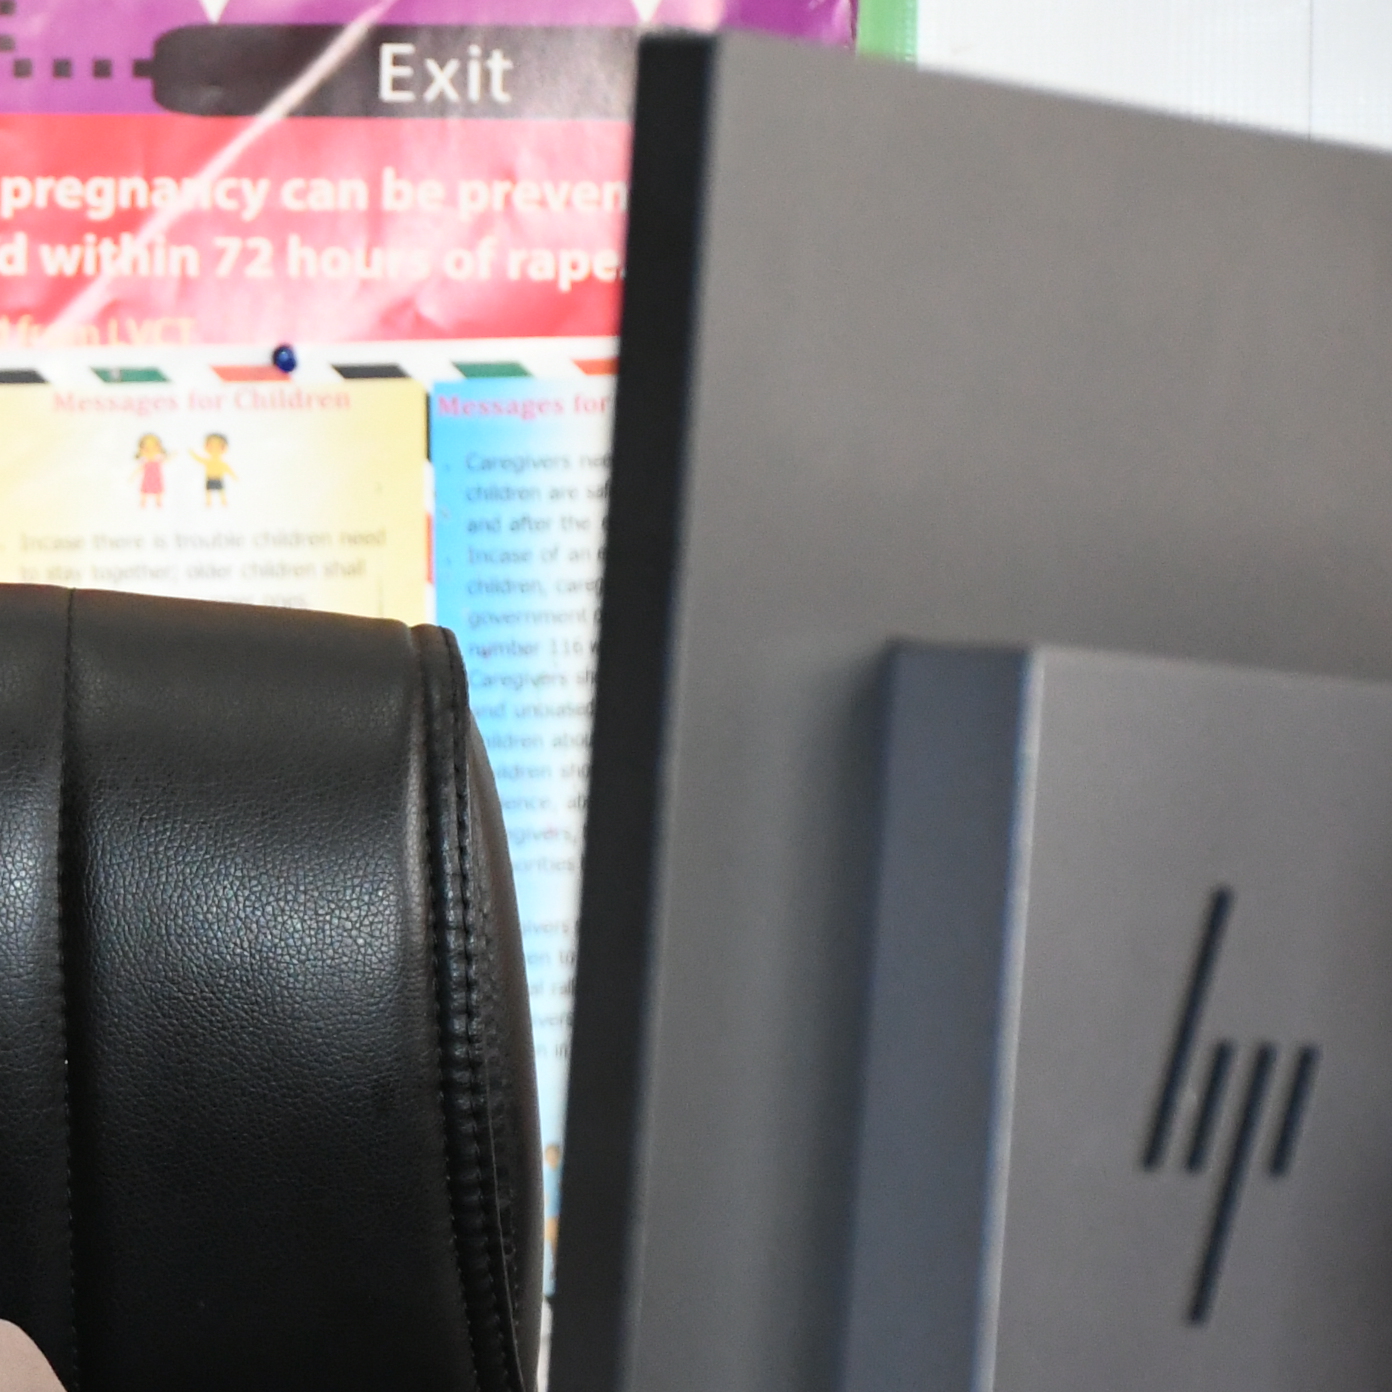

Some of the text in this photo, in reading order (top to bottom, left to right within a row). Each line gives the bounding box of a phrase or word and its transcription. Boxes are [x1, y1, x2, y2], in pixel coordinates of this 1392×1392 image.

[378, 42, 514, 103] Exit
[279, 177, 369, 211] can
[382, 165, 445, 212] be
[39, 232, 199, 277] within
[213, 236, 274, 279] 72
[286, 233, 432, 280] hours
[443, 236, 498, 281] of
[52, 388, 352, 417] Messages for Children
[437, 394, 607, 421] Messages for
